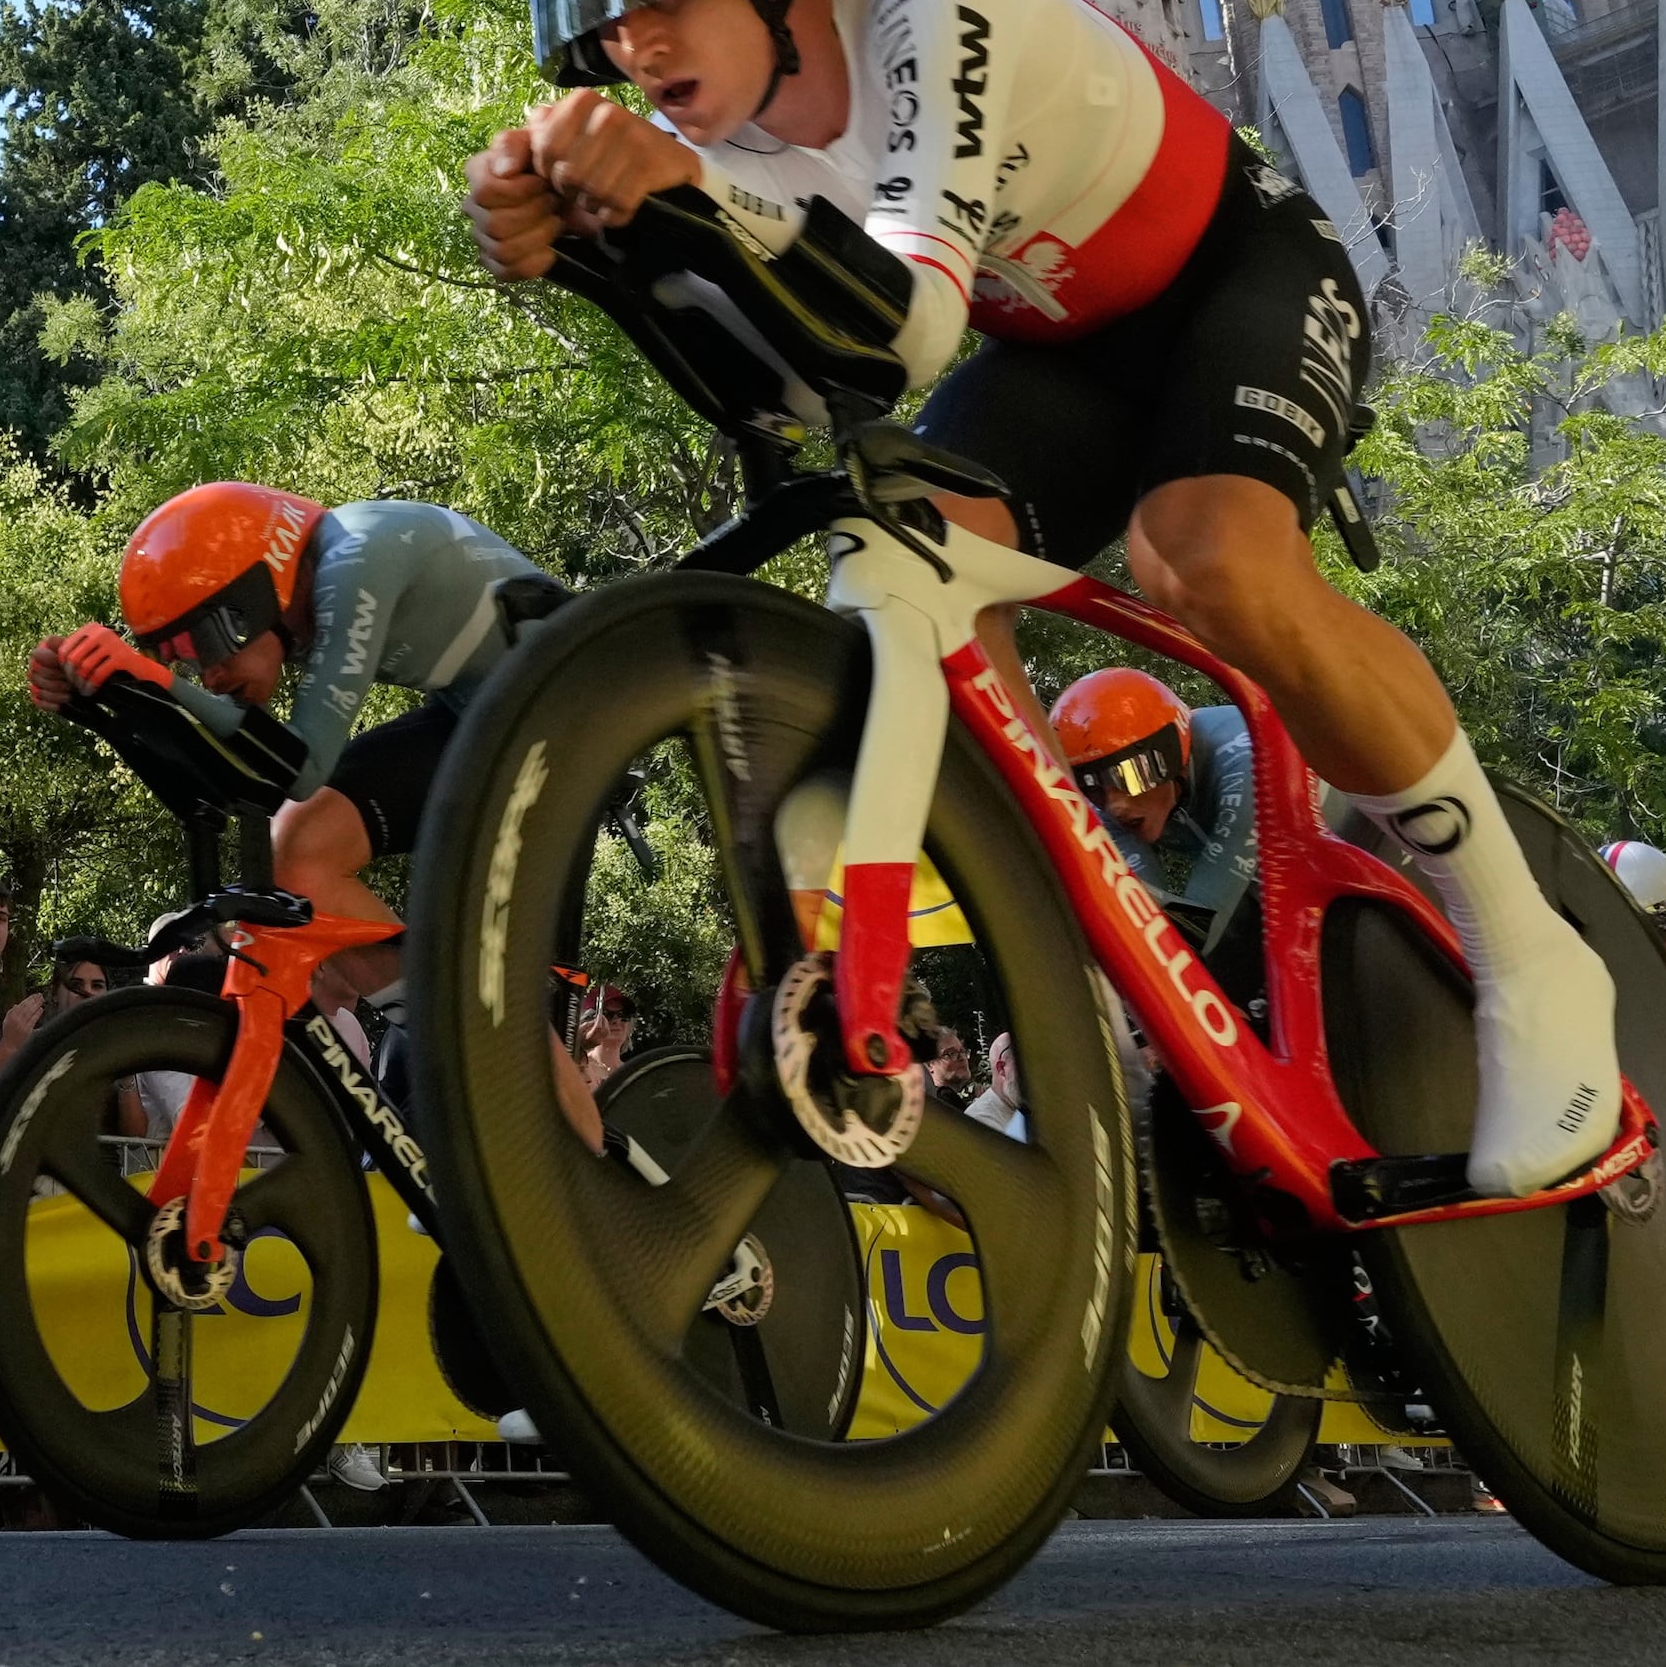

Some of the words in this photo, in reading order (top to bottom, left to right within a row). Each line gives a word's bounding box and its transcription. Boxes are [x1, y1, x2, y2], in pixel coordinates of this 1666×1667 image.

[950, 4, 992, 160] wtw
[1241, 388, 1325, 446] GOBIK
[340, 588, 378, 675] wtw
[1214, 771, 1244, 838] INEOS
[973, 670, 1238, 1047] PINARELLO
[305, 1014, 439, 1206] PINAREL
[1555, 1082, 1600, 1134] GOBIK
[1592, 1135, 1646, 1184] MOST
[880, 1249, 990, 1335] LC
